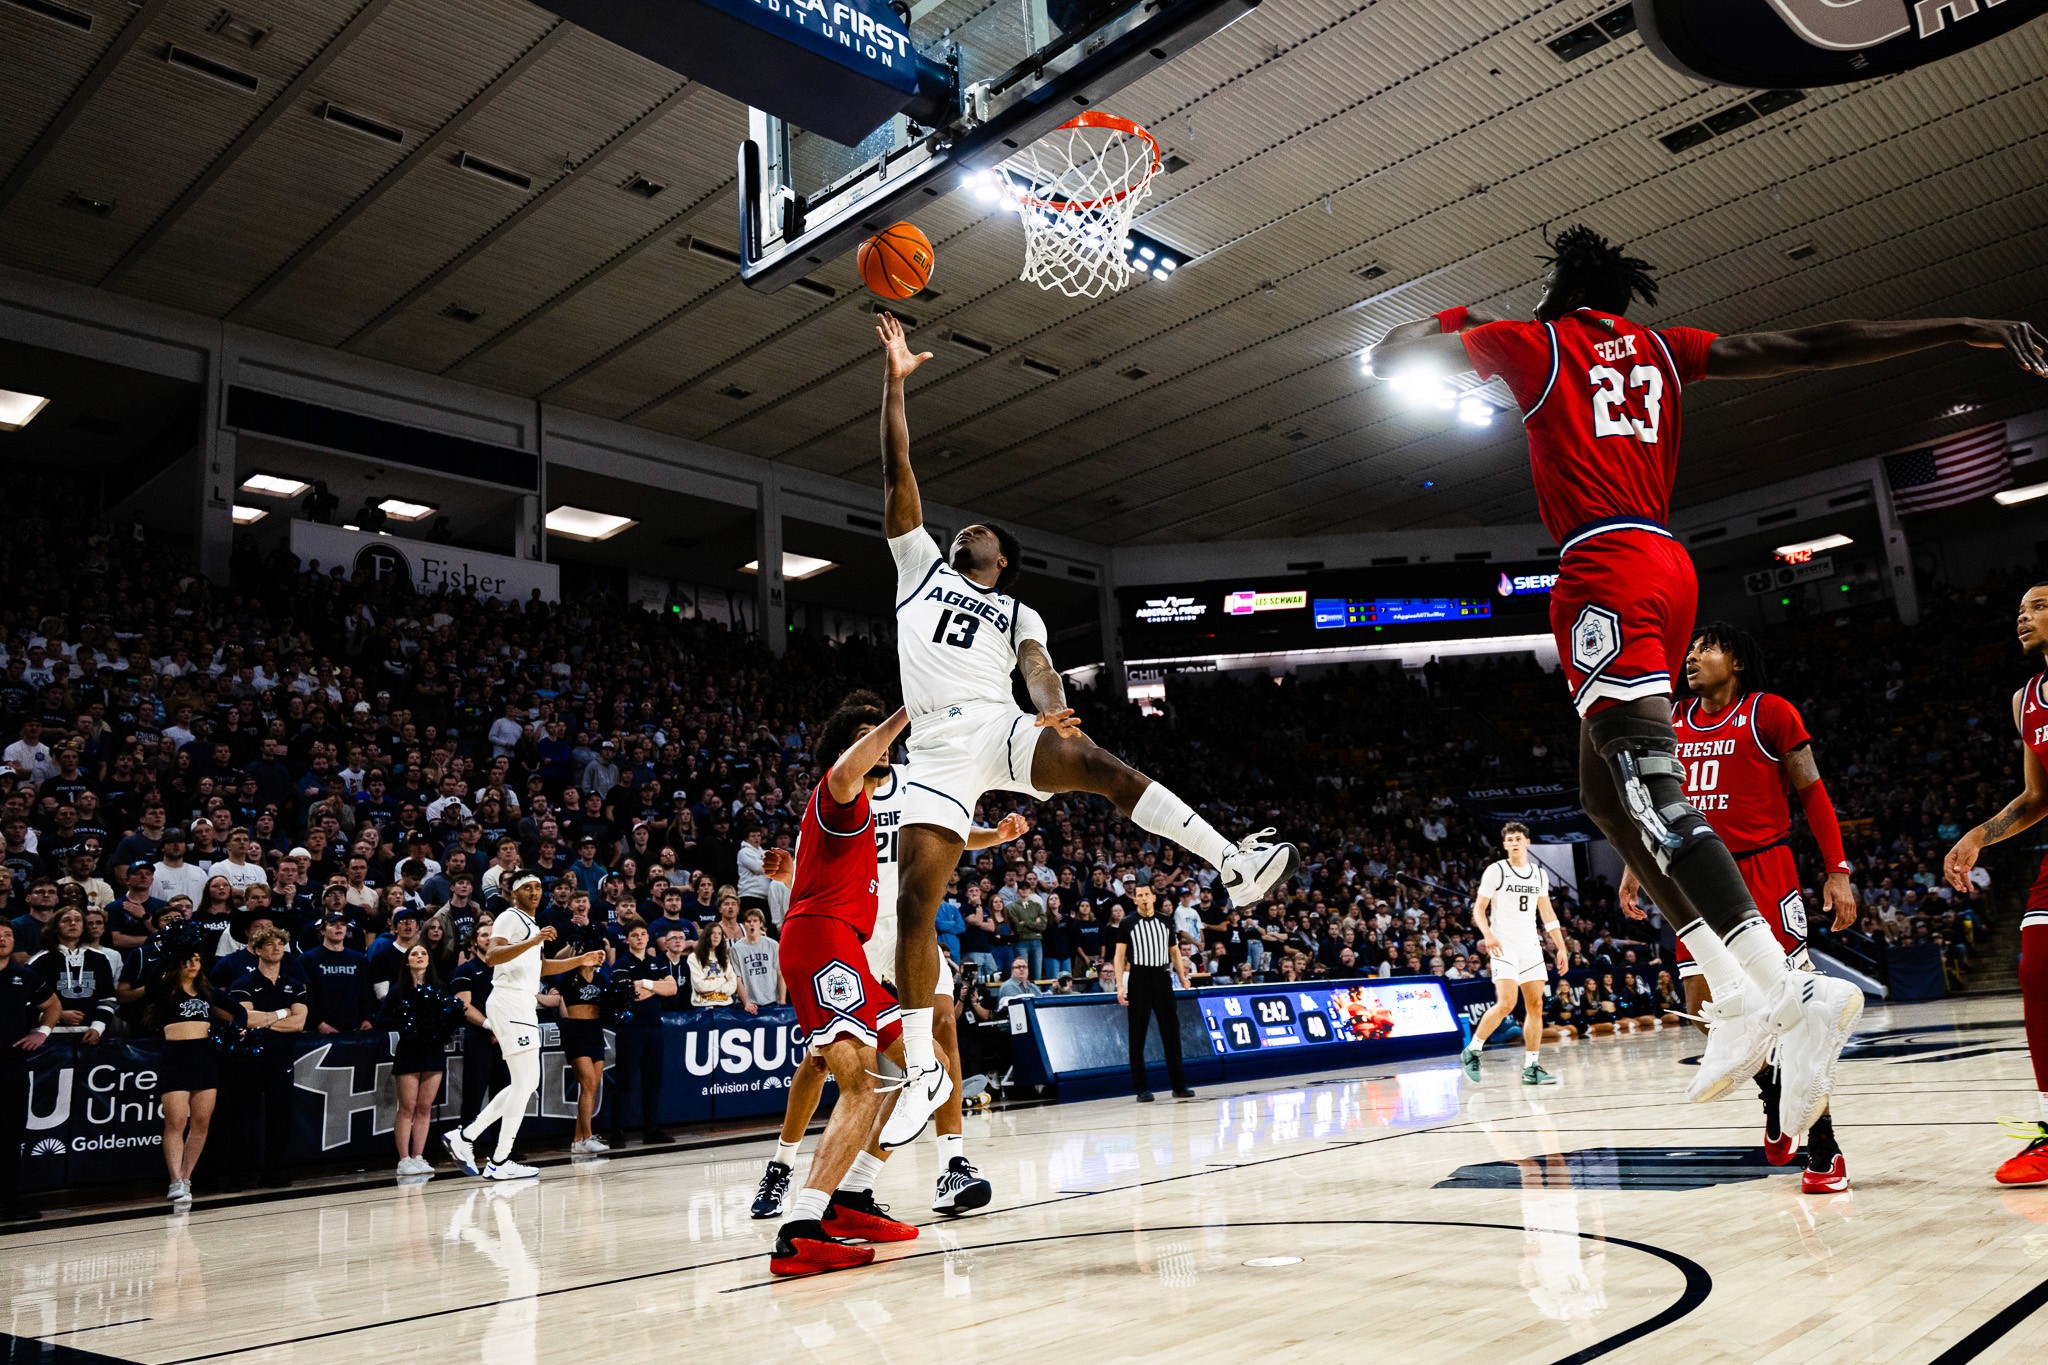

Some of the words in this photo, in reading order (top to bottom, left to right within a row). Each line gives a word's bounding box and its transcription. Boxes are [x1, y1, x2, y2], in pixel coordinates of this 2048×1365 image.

[750, 0, 807, 25] DIT
[822, 22, 893, 68] UNION
[833, 2, 910, 58] FIRST
[1594, 334, 1638, 362] SECK
[1588, 364, 1664, 444] 23
[420, 557, 507, 595] Fisher
[924, 586, 1010, 634] AGGIES
[1255, 596, 1268, 606] LES
[1269, 595, 1304, 605] SCHWAB
[1136, 606, 1179, 618] AMERICA
[1179, 605, 1207, 616] FIRST
[932, 608, 980, 649] 13
[1674, 738, 1736, 758] FRESNO
[1687, 760, 1720, 792] 10
[1467, 787, 1511, 799] UTAH
[1515, 783, 1565, 795] STATE
[873, 810, 902, 827] GIE
[876, 831, 898, 864] 21
[1506, 884, 1540, 894] AGGIES
[1519, 895, 1529, 911] 8
[318, 963, 358, 975] HURD
[743, 952, 769, 965] CLUB
[749, 966, 768, 976] FED
[1258, 1000, 1290, 1023] 2:42
[685, 1025, 787, 1077] USU
[87, 1064, 159, 1093] Cre
[701, 1086, 708, 1095] a
[710, 1081, 749, 1095] division
[750, 1079, 760, 1091] of
[71, 1133, 163, 1152] Goldenwe
